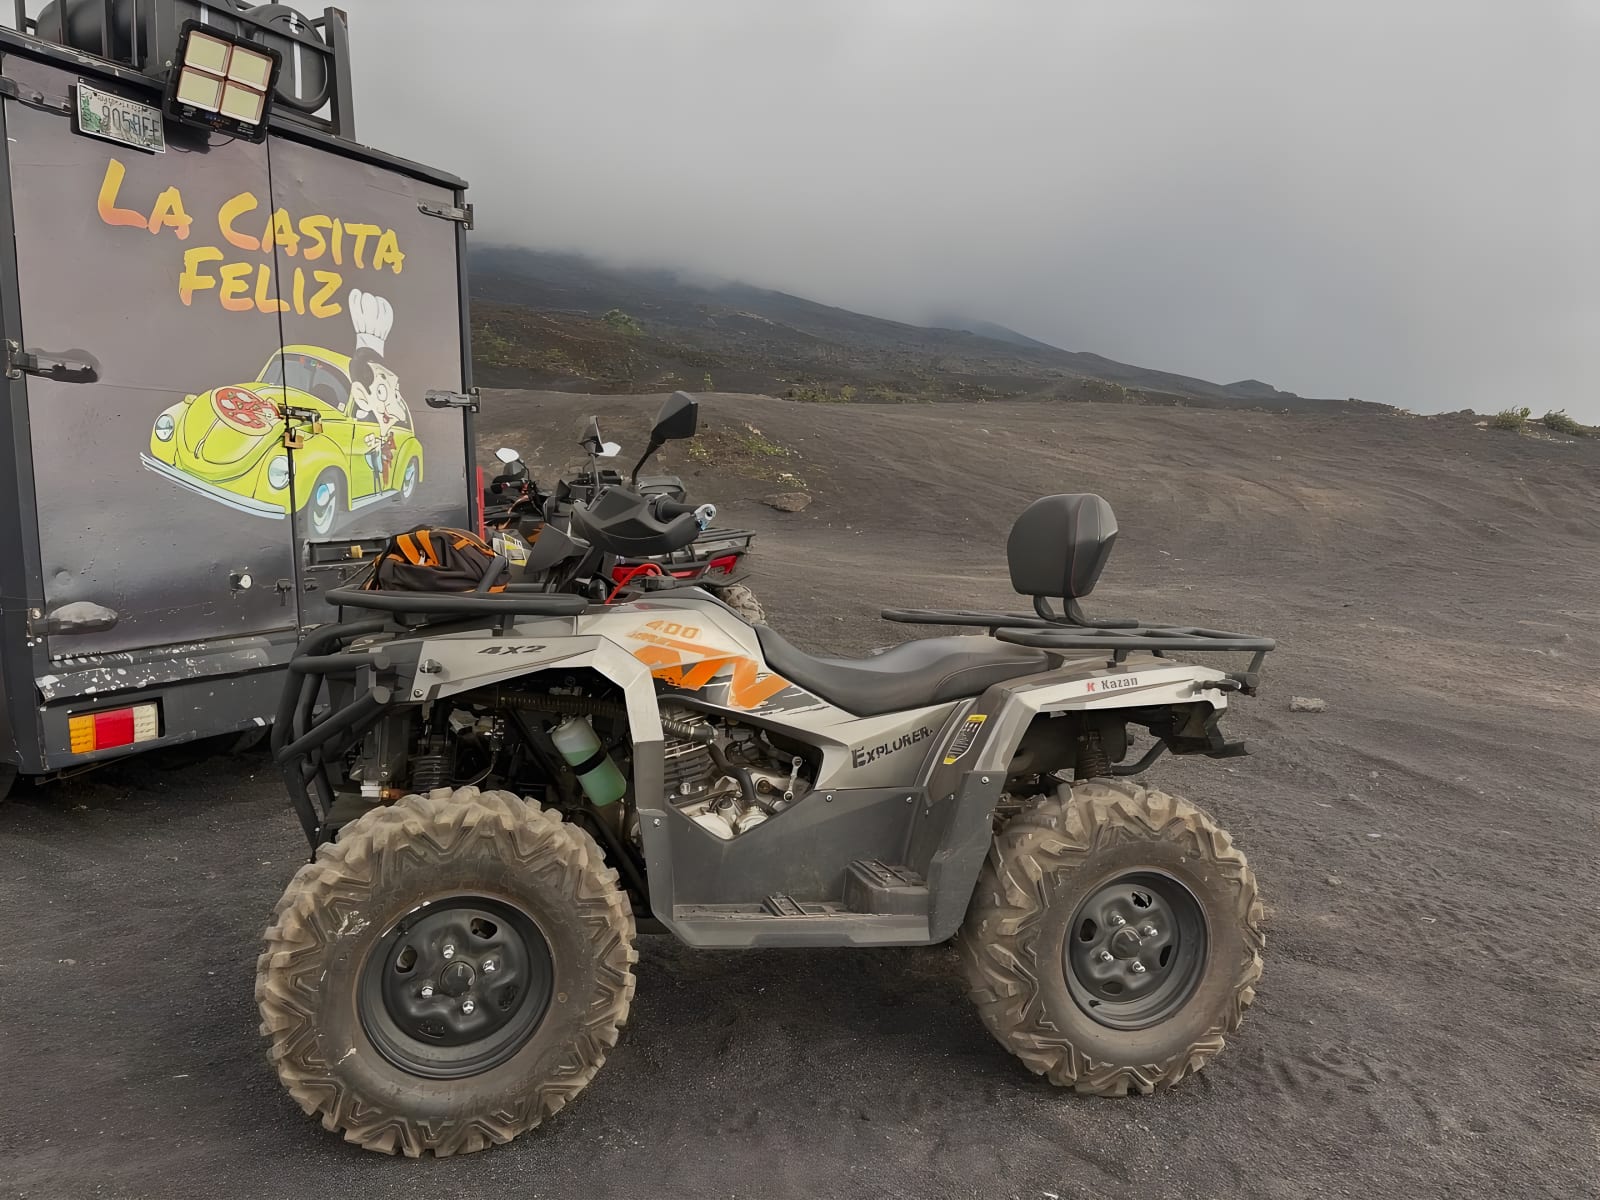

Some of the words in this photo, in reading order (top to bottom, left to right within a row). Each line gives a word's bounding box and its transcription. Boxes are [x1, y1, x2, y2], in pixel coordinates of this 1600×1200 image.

[98, 158, 193, 240] LA
[218, 191, 406, 274] CASITA
[178, 246, 343, 319] FELIZ
[645, 620, 700, 639] 400
[477, 644, 547, 656] 4X2
[1101, 677, 1138, 690] Kazan
